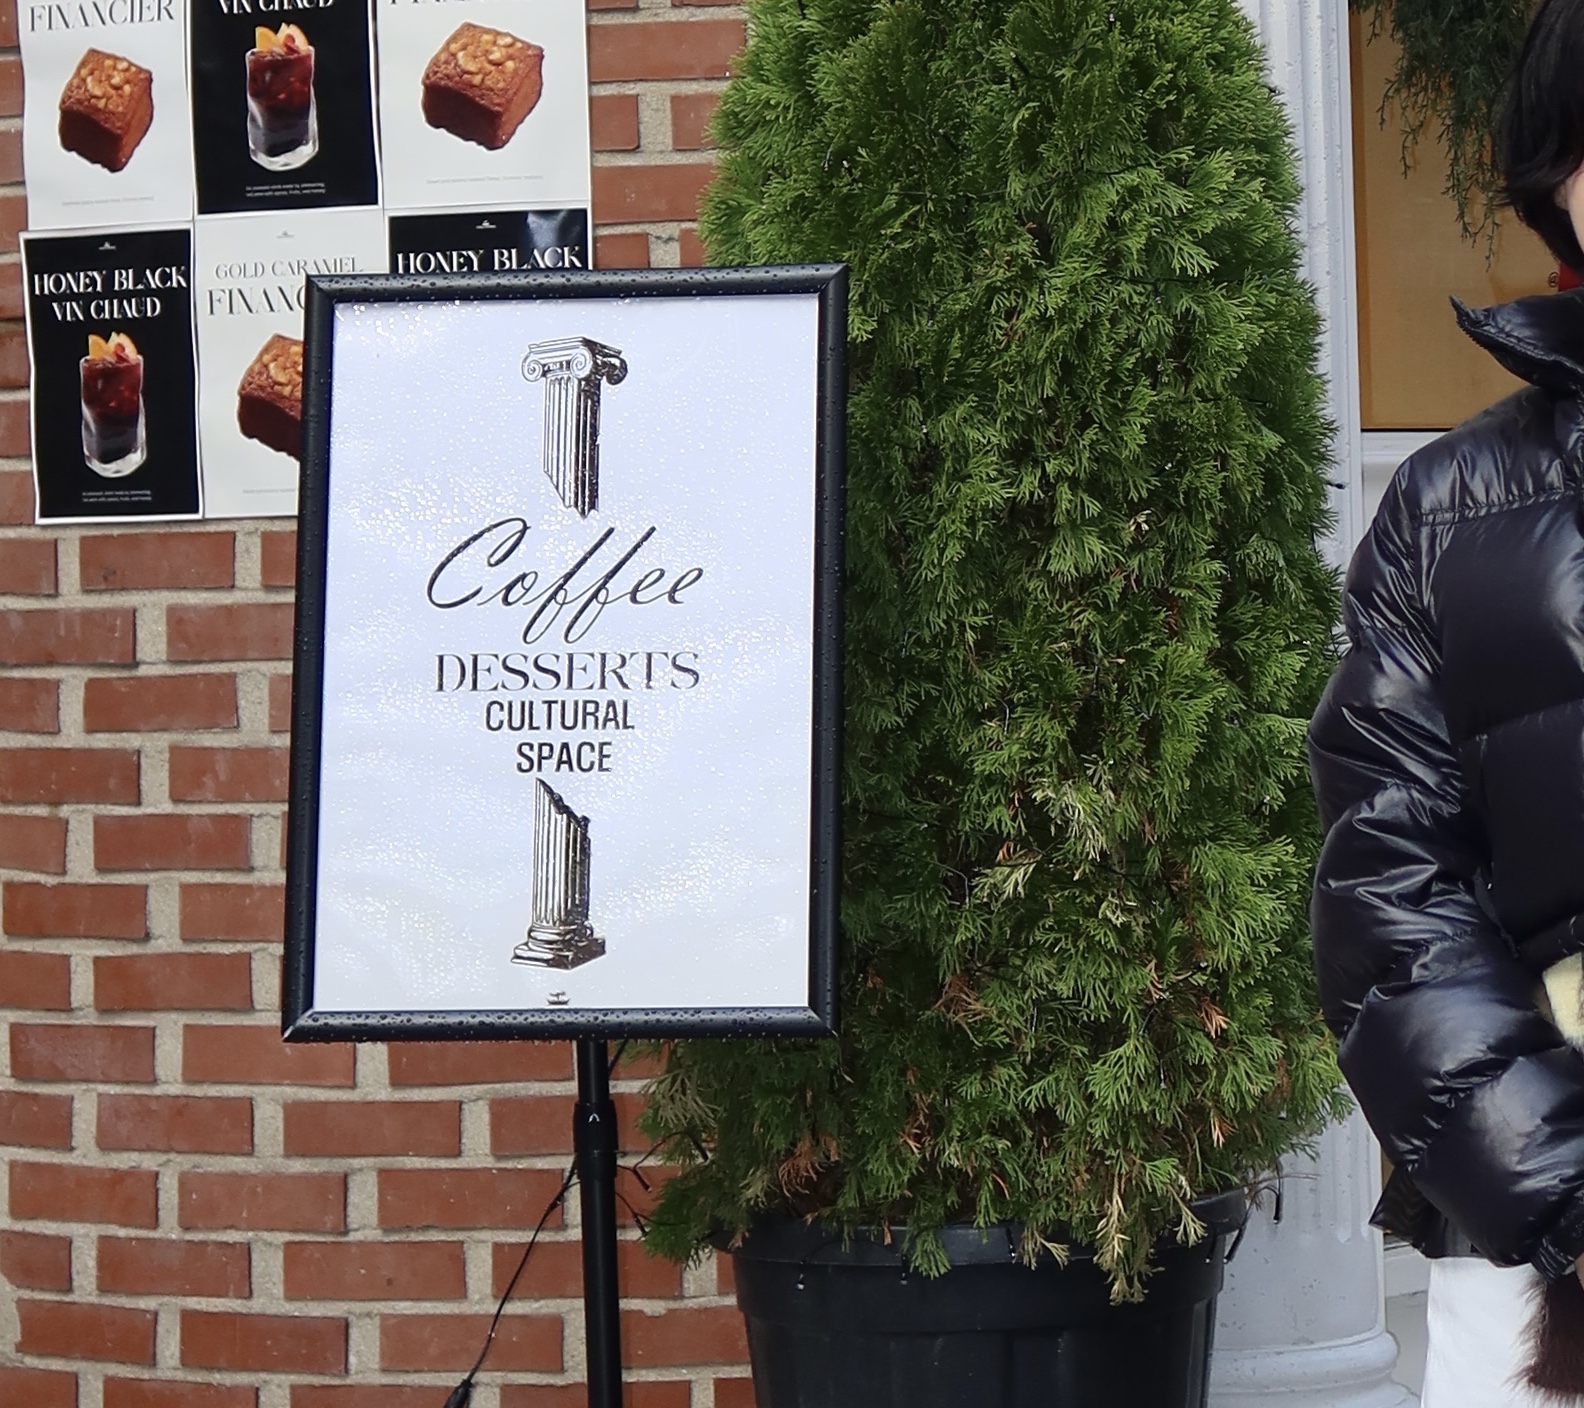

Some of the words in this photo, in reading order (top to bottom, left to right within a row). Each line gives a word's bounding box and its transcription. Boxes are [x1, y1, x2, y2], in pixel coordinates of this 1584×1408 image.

[215, 262, 265, 280] GOLD
[272, 256, 363, 277] CARAMEL
[397, 250, 484, 274] HONEY
[493, 245, 582, 270] BLACK
[34, 270, 106, 295] HONEY
[114, 266, 187, 291] BLACK
[52, 300, 84, 321] VIN
[90, 297, 161, 319] CHAUD
[427, 517, 704, 645] Coffee
[435, 652, 700, 693] DESSERTS
[485, 699, 635, 733] CULTURAL
[516, 741, 611, 773] SPACE
